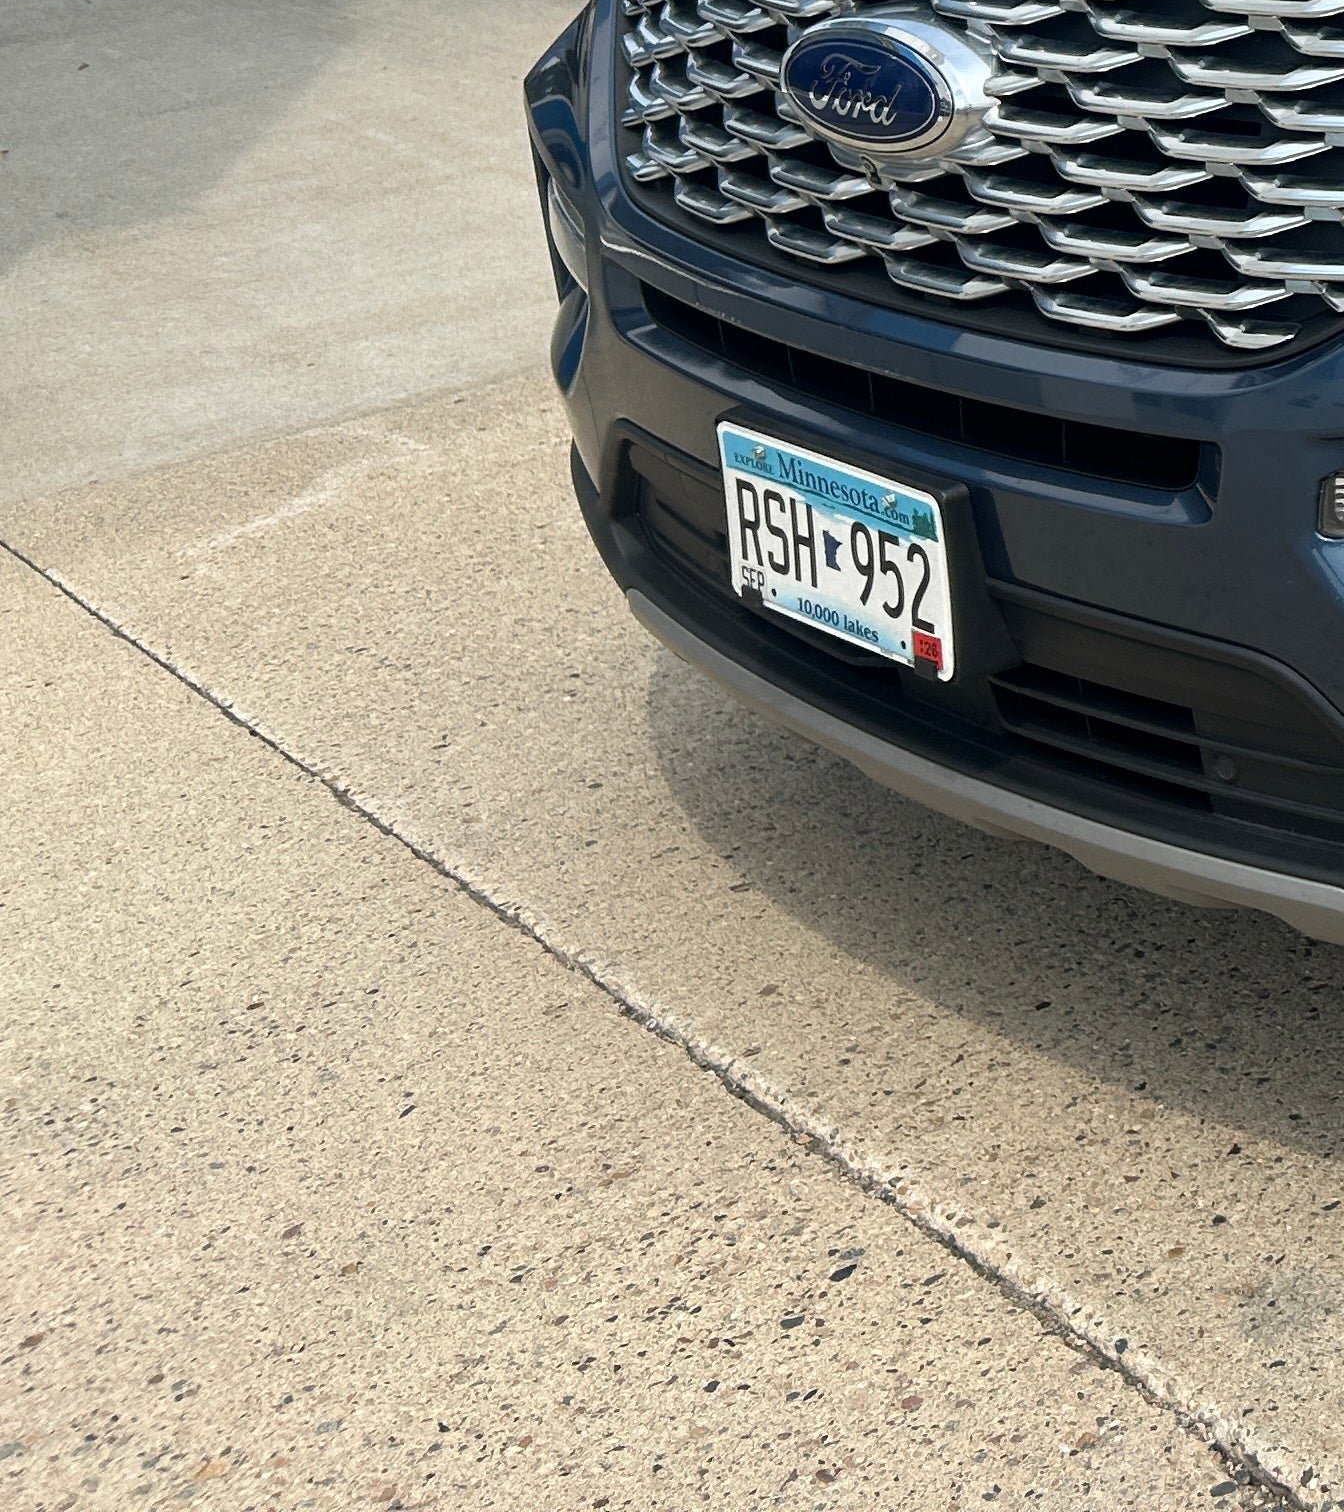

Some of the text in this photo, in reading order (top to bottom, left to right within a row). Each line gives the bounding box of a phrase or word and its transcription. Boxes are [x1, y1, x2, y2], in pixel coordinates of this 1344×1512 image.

[808, 53, 903, 127] Ford
[734, 452, 774, 475] EXPLORE
[735, 478, 935, 635] RSH 952
[741, 565, 765, 591] SEP
[797, 597, 879, 643] 10,000 lakes
